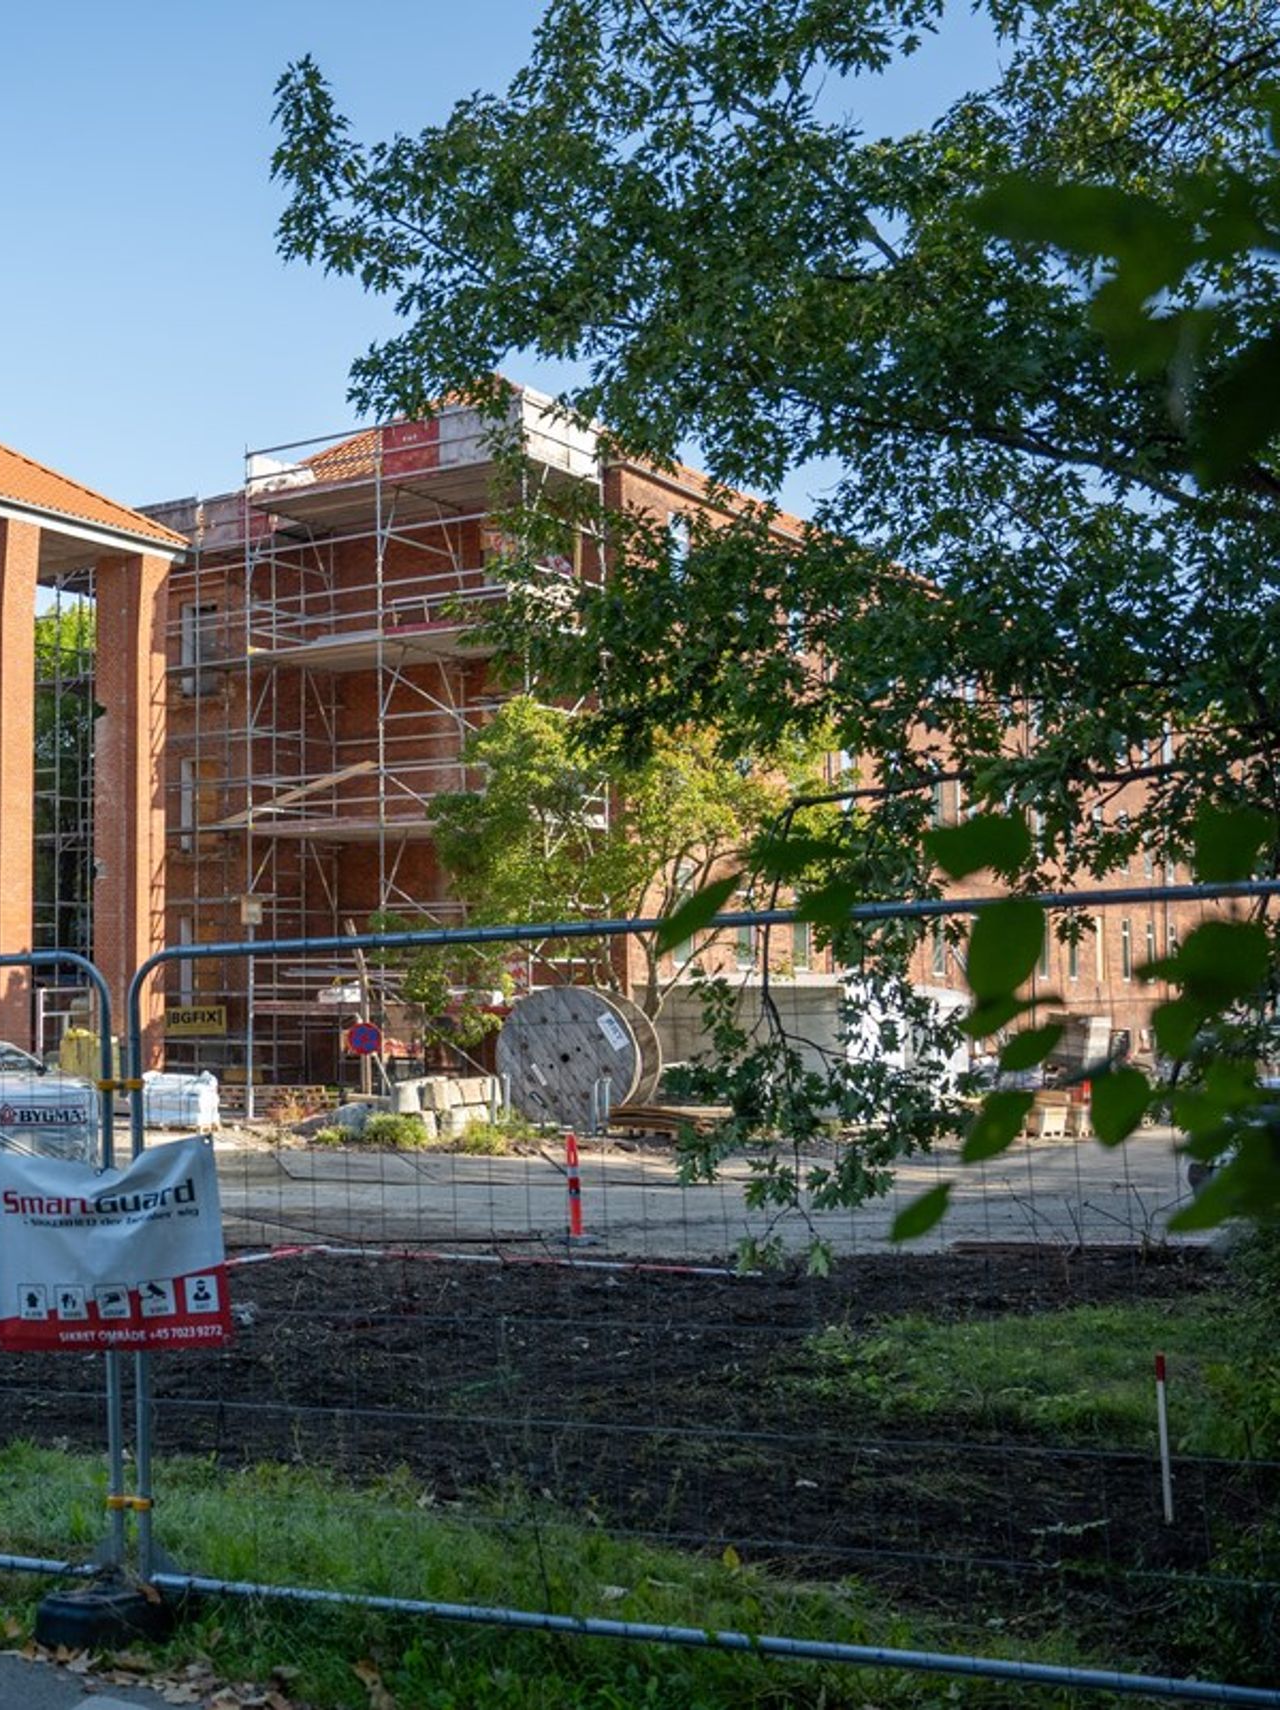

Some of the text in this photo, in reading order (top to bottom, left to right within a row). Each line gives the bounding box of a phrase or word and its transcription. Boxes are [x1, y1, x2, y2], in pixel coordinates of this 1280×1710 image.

[19, 1108, 82, 1122] BYGMA
[58, 1330, 95, 1343] SIKRET
[99, 1327, 147, 1343] OMRÅDE
